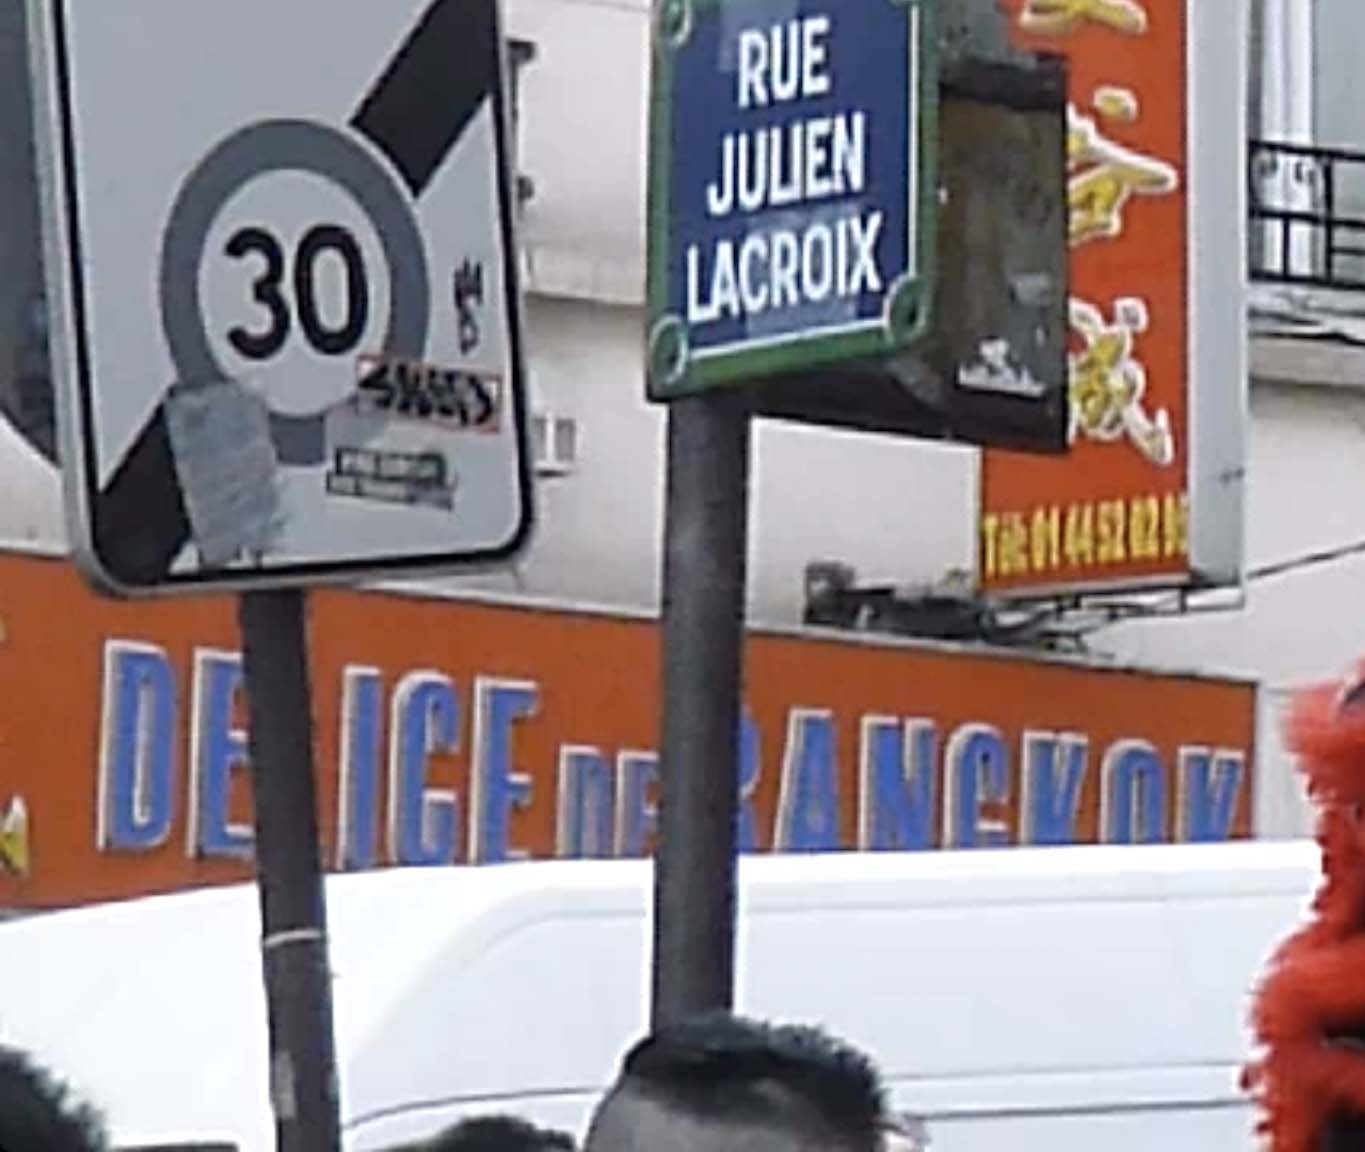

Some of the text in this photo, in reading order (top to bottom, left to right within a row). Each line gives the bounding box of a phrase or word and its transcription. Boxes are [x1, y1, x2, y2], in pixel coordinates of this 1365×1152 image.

[739, 15, 830, 107] RUE
[706, 111, 866, 218] JULIEN
[225, 224, 370, 360] 30
[687, 212, 884, 322] LACROIX
[97, 637, 539, 870] DEICE
